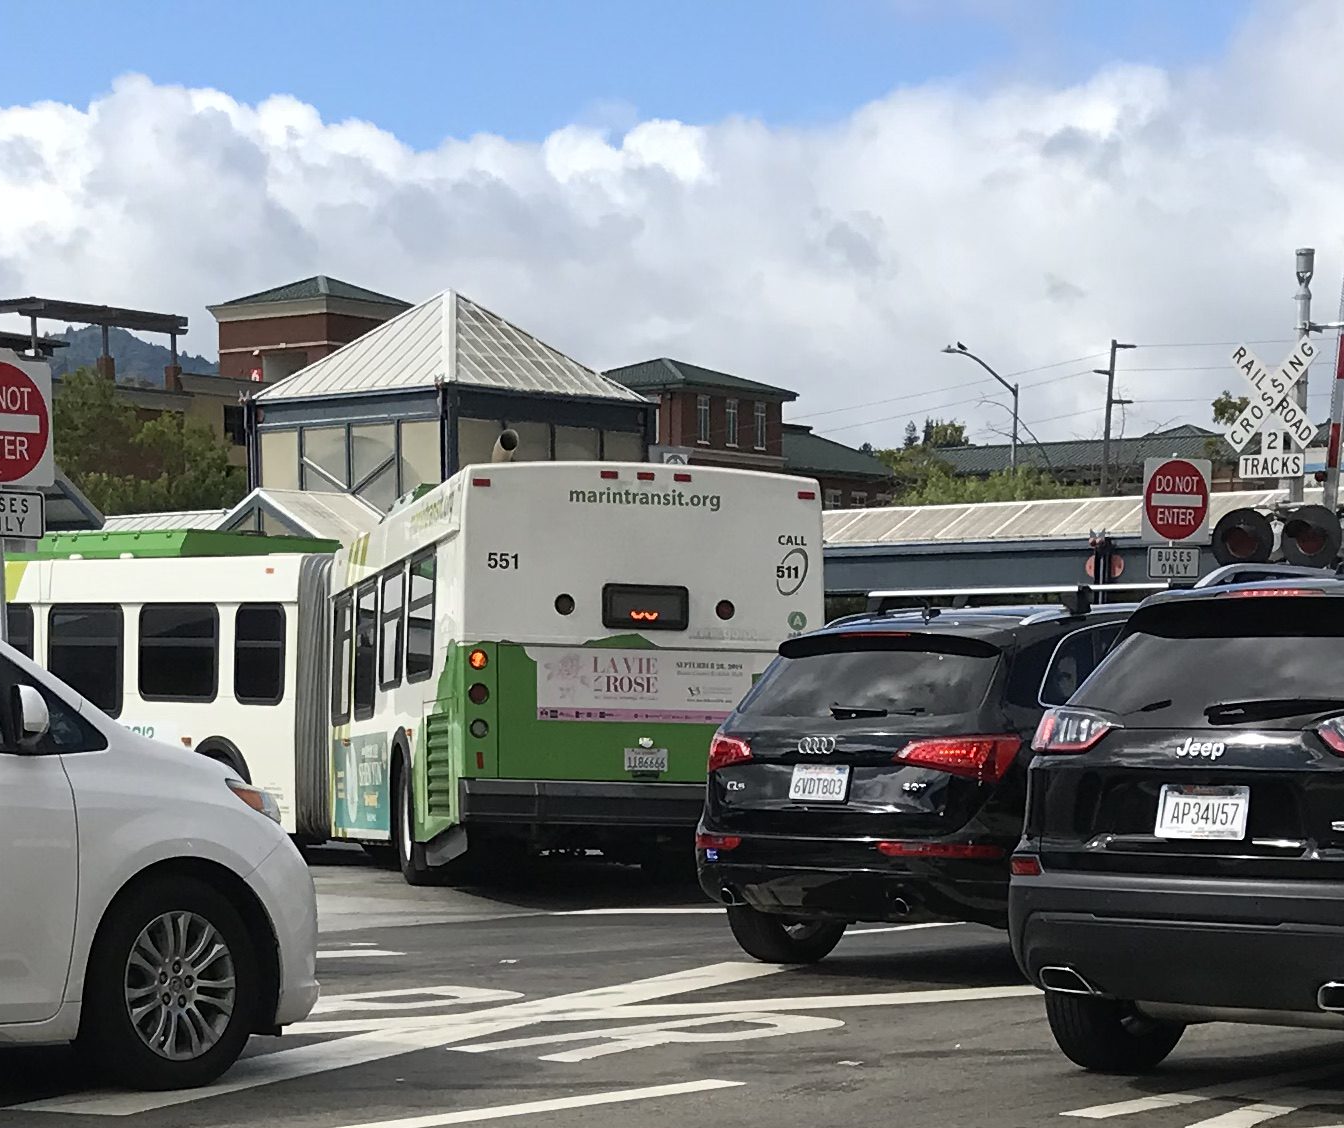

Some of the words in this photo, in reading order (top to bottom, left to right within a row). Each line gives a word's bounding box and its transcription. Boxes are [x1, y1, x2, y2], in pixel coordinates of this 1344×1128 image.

[1230, 342, 1314, 445] CROSSING
[1267, 431, 1278, 449] 2
[1243, 456, 1301, 476] TRACKS
[1156, 475, 1173, 492] DO
[1175, 476, 1199, 492] NOT
[569, 489, 721, 511] marintransit.org
[1157, 508, 1195, 525] ENTER
[778, 535, 807, 546] CALL
[487, 552, 518, 569] 551
[1157, 551, 1192, 562] BUSES
[776, 565, 799, 579] 511
[1161, 563, 1189, 575] ONLY
[606, 675, 659, 694] ROSE
[1176, 738, 1225, 760] Jeep
[793, 777, 844, 796] 6VDT803
[1170, 801, 1240, 826] AP34V57
